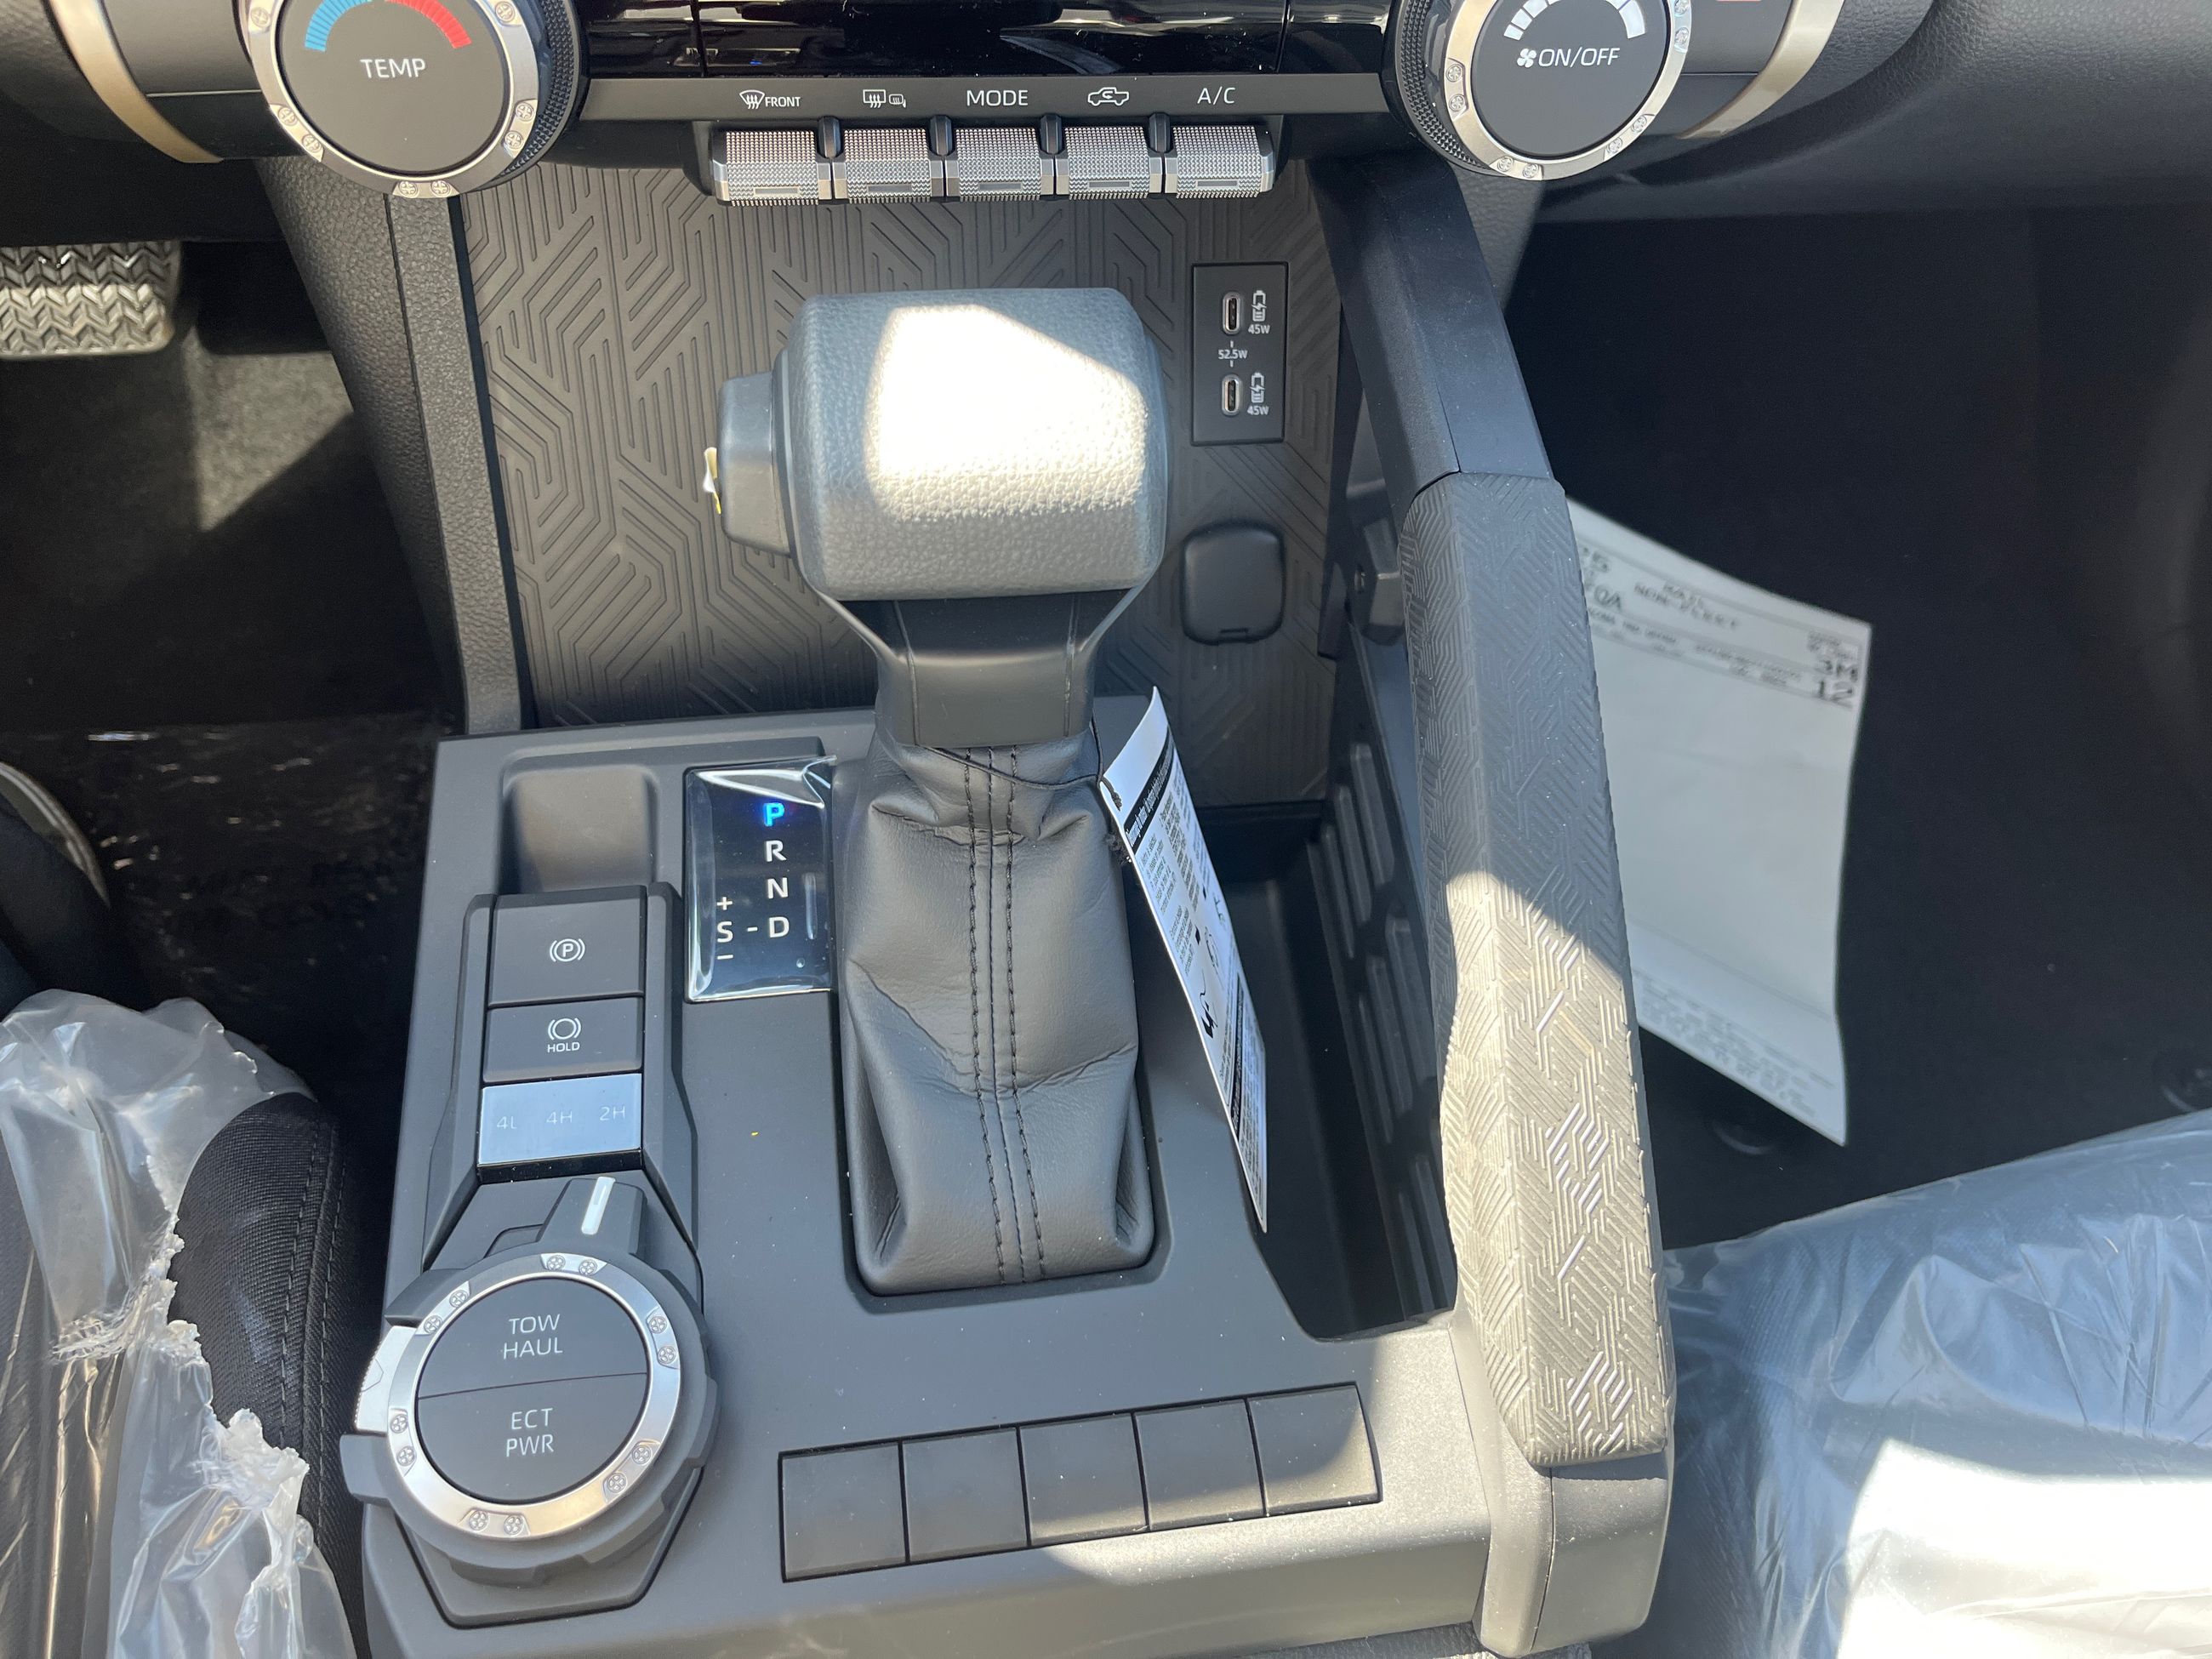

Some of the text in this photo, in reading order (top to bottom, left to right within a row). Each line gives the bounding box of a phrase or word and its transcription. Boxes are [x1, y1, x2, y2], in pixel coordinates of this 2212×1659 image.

[360, 57, 426, 78] TEMP
[1538, 47, 1621, 68] ON/OFF
[765, 96, 801, 108] FRONT
[966, 88, 1029, 107] MODE
[1197, 87, 1235, 105] A/C
[1247, 324, 1270, 335] 45W
[1218, 349, 1248, 360] 52.5W
[1246, 405, 1269, 415] 45W
[762, 802, 785, 827] P
[765, 840, 787, 863] R
[767, 877, 789, 899] N
[716, 921, 734, 944] S
[768, 916, 790, 938] D
[547, 1040, 580, 1053] HOLD
[496, 1105, 625, 1130] 4L 4H 2H
[508, 1314, 561, 1336] TOW
[502, 1337, 563, 1360] HAUL
[510, 1407, 553, 1430] ECT
[505, 1434, 555, 1457] PWR
